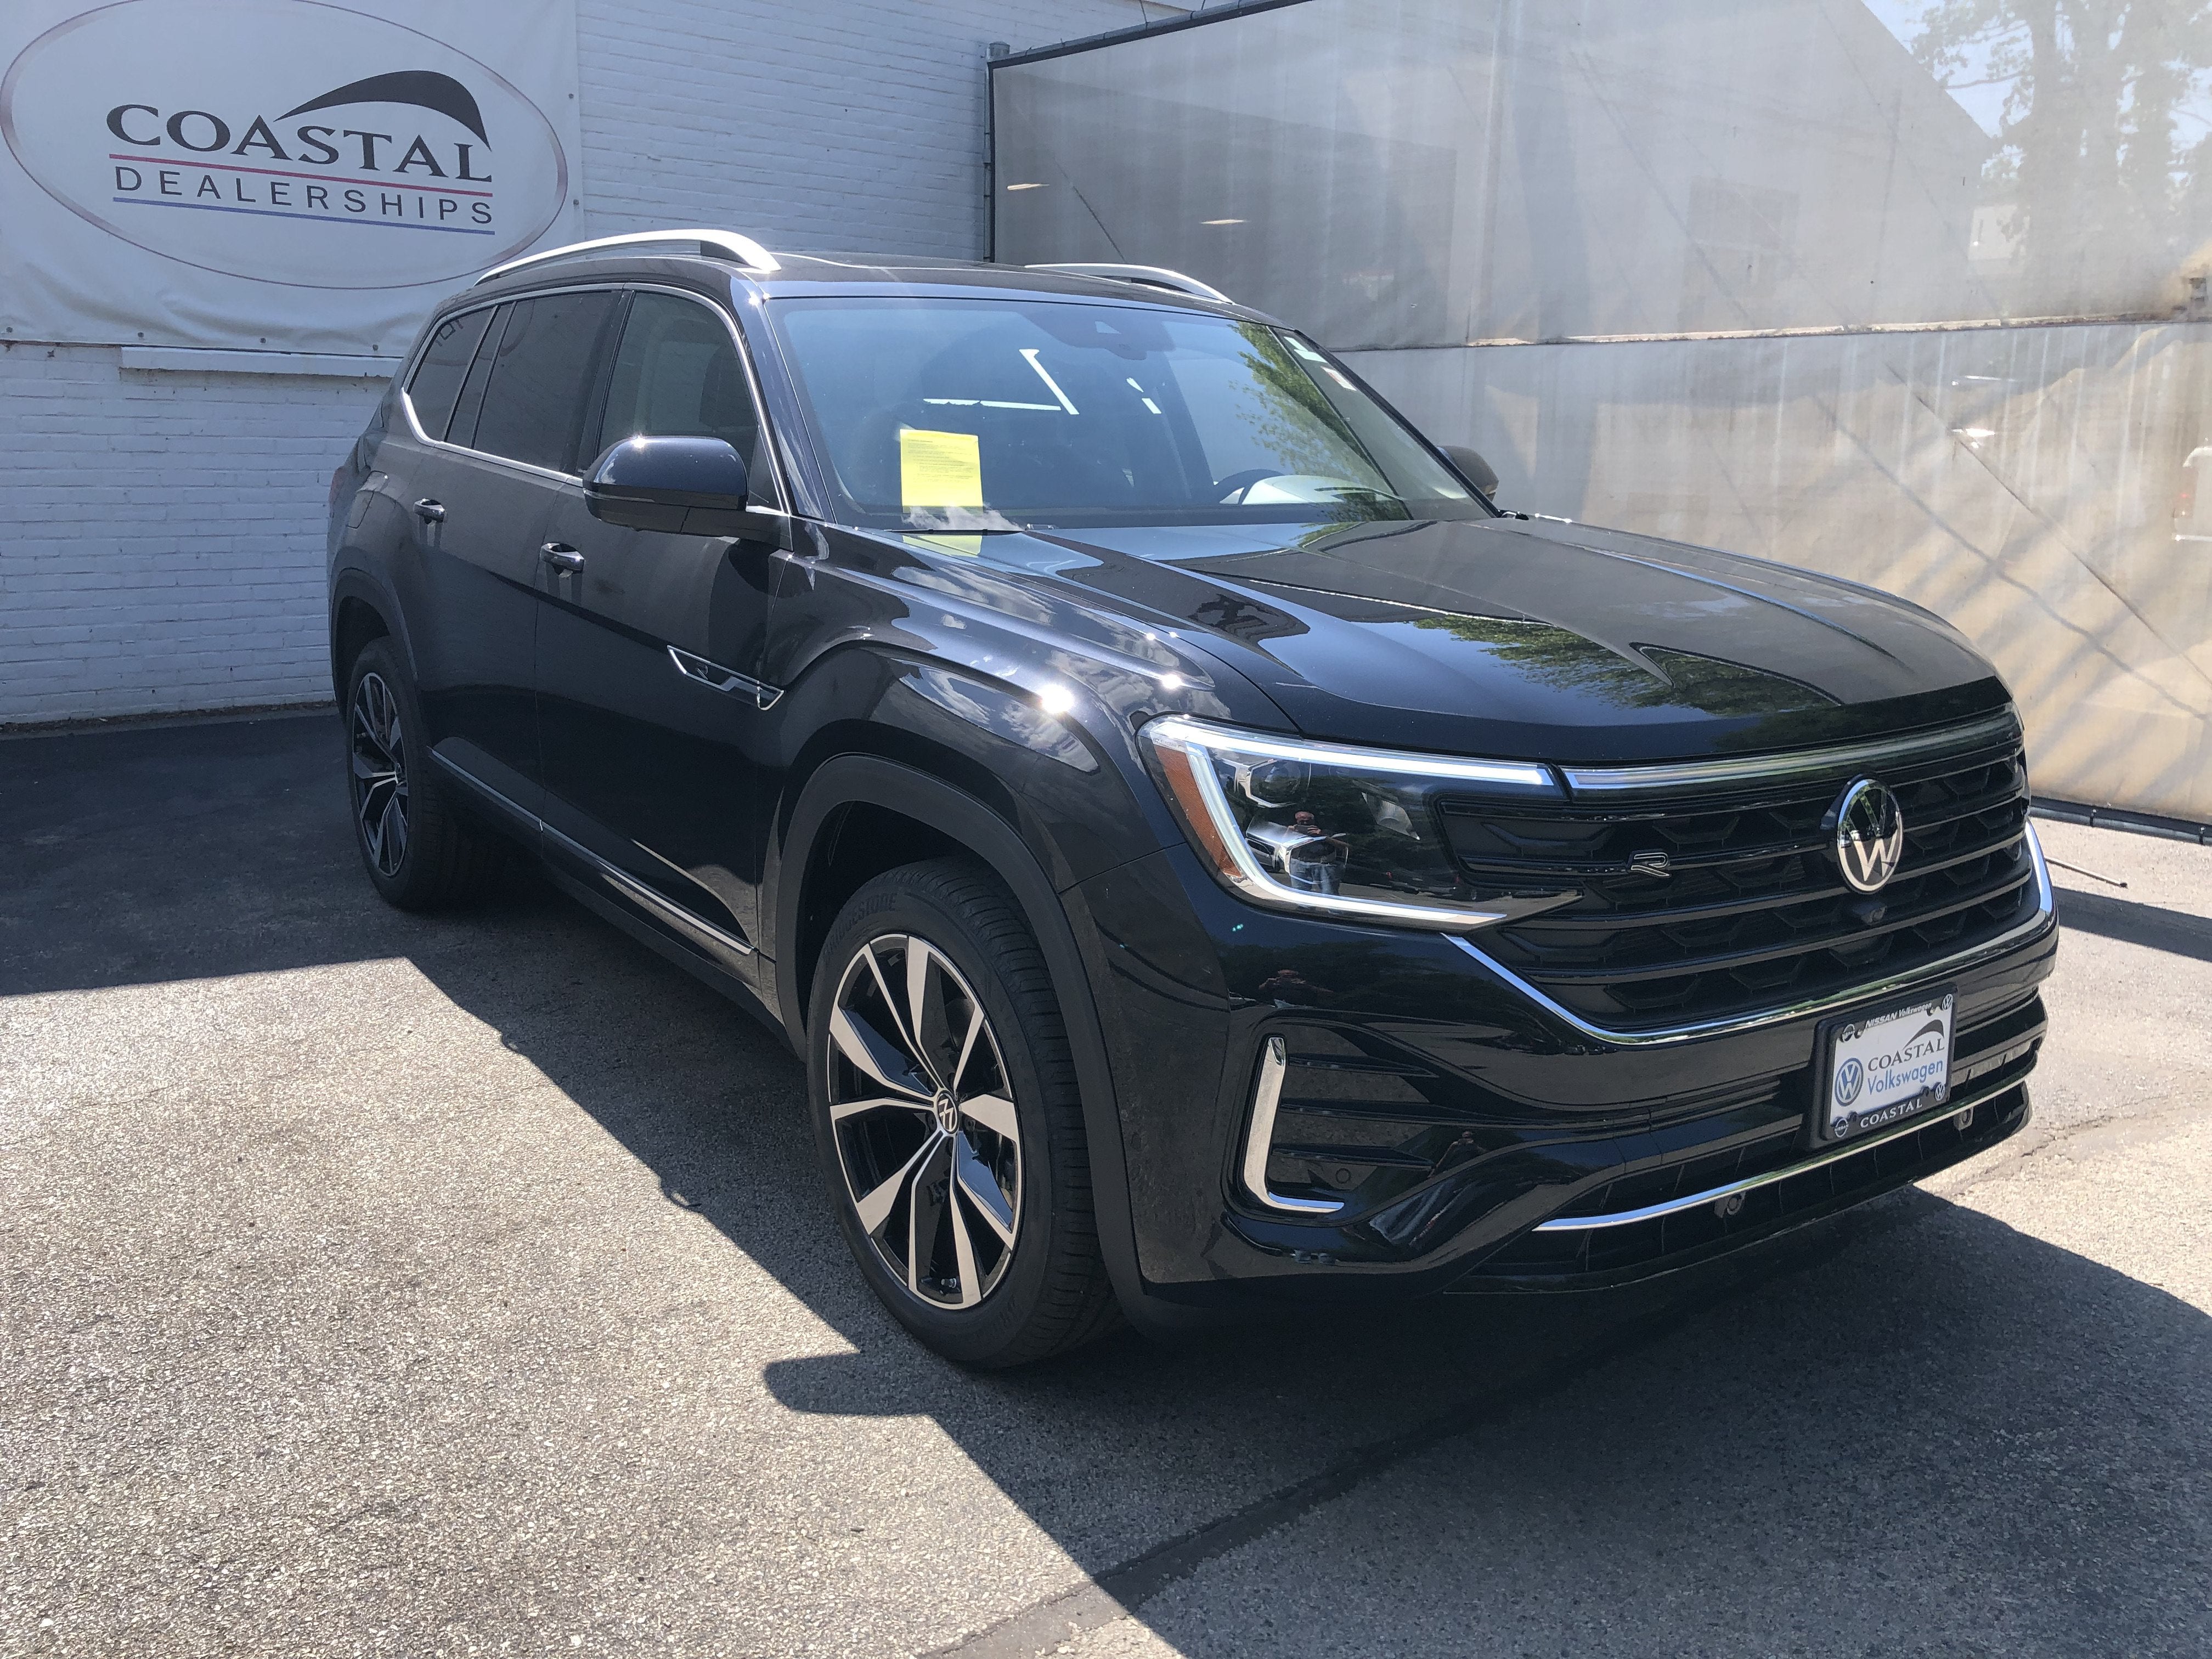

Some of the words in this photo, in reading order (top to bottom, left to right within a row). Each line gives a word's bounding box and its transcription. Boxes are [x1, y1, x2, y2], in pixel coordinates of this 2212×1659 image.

[106, 104, 492, 183] COASTAL
[115, 166, 492, 224] DEALERSHIPS
[1865, 1011, 1898, 1028] NISSAN
[1867, 1038, 1945, 1071] COASTAL
[1867, 1060, 1943, 1095] Volkswagen
[1860, 1098, 1923, 1128] COASTAL
